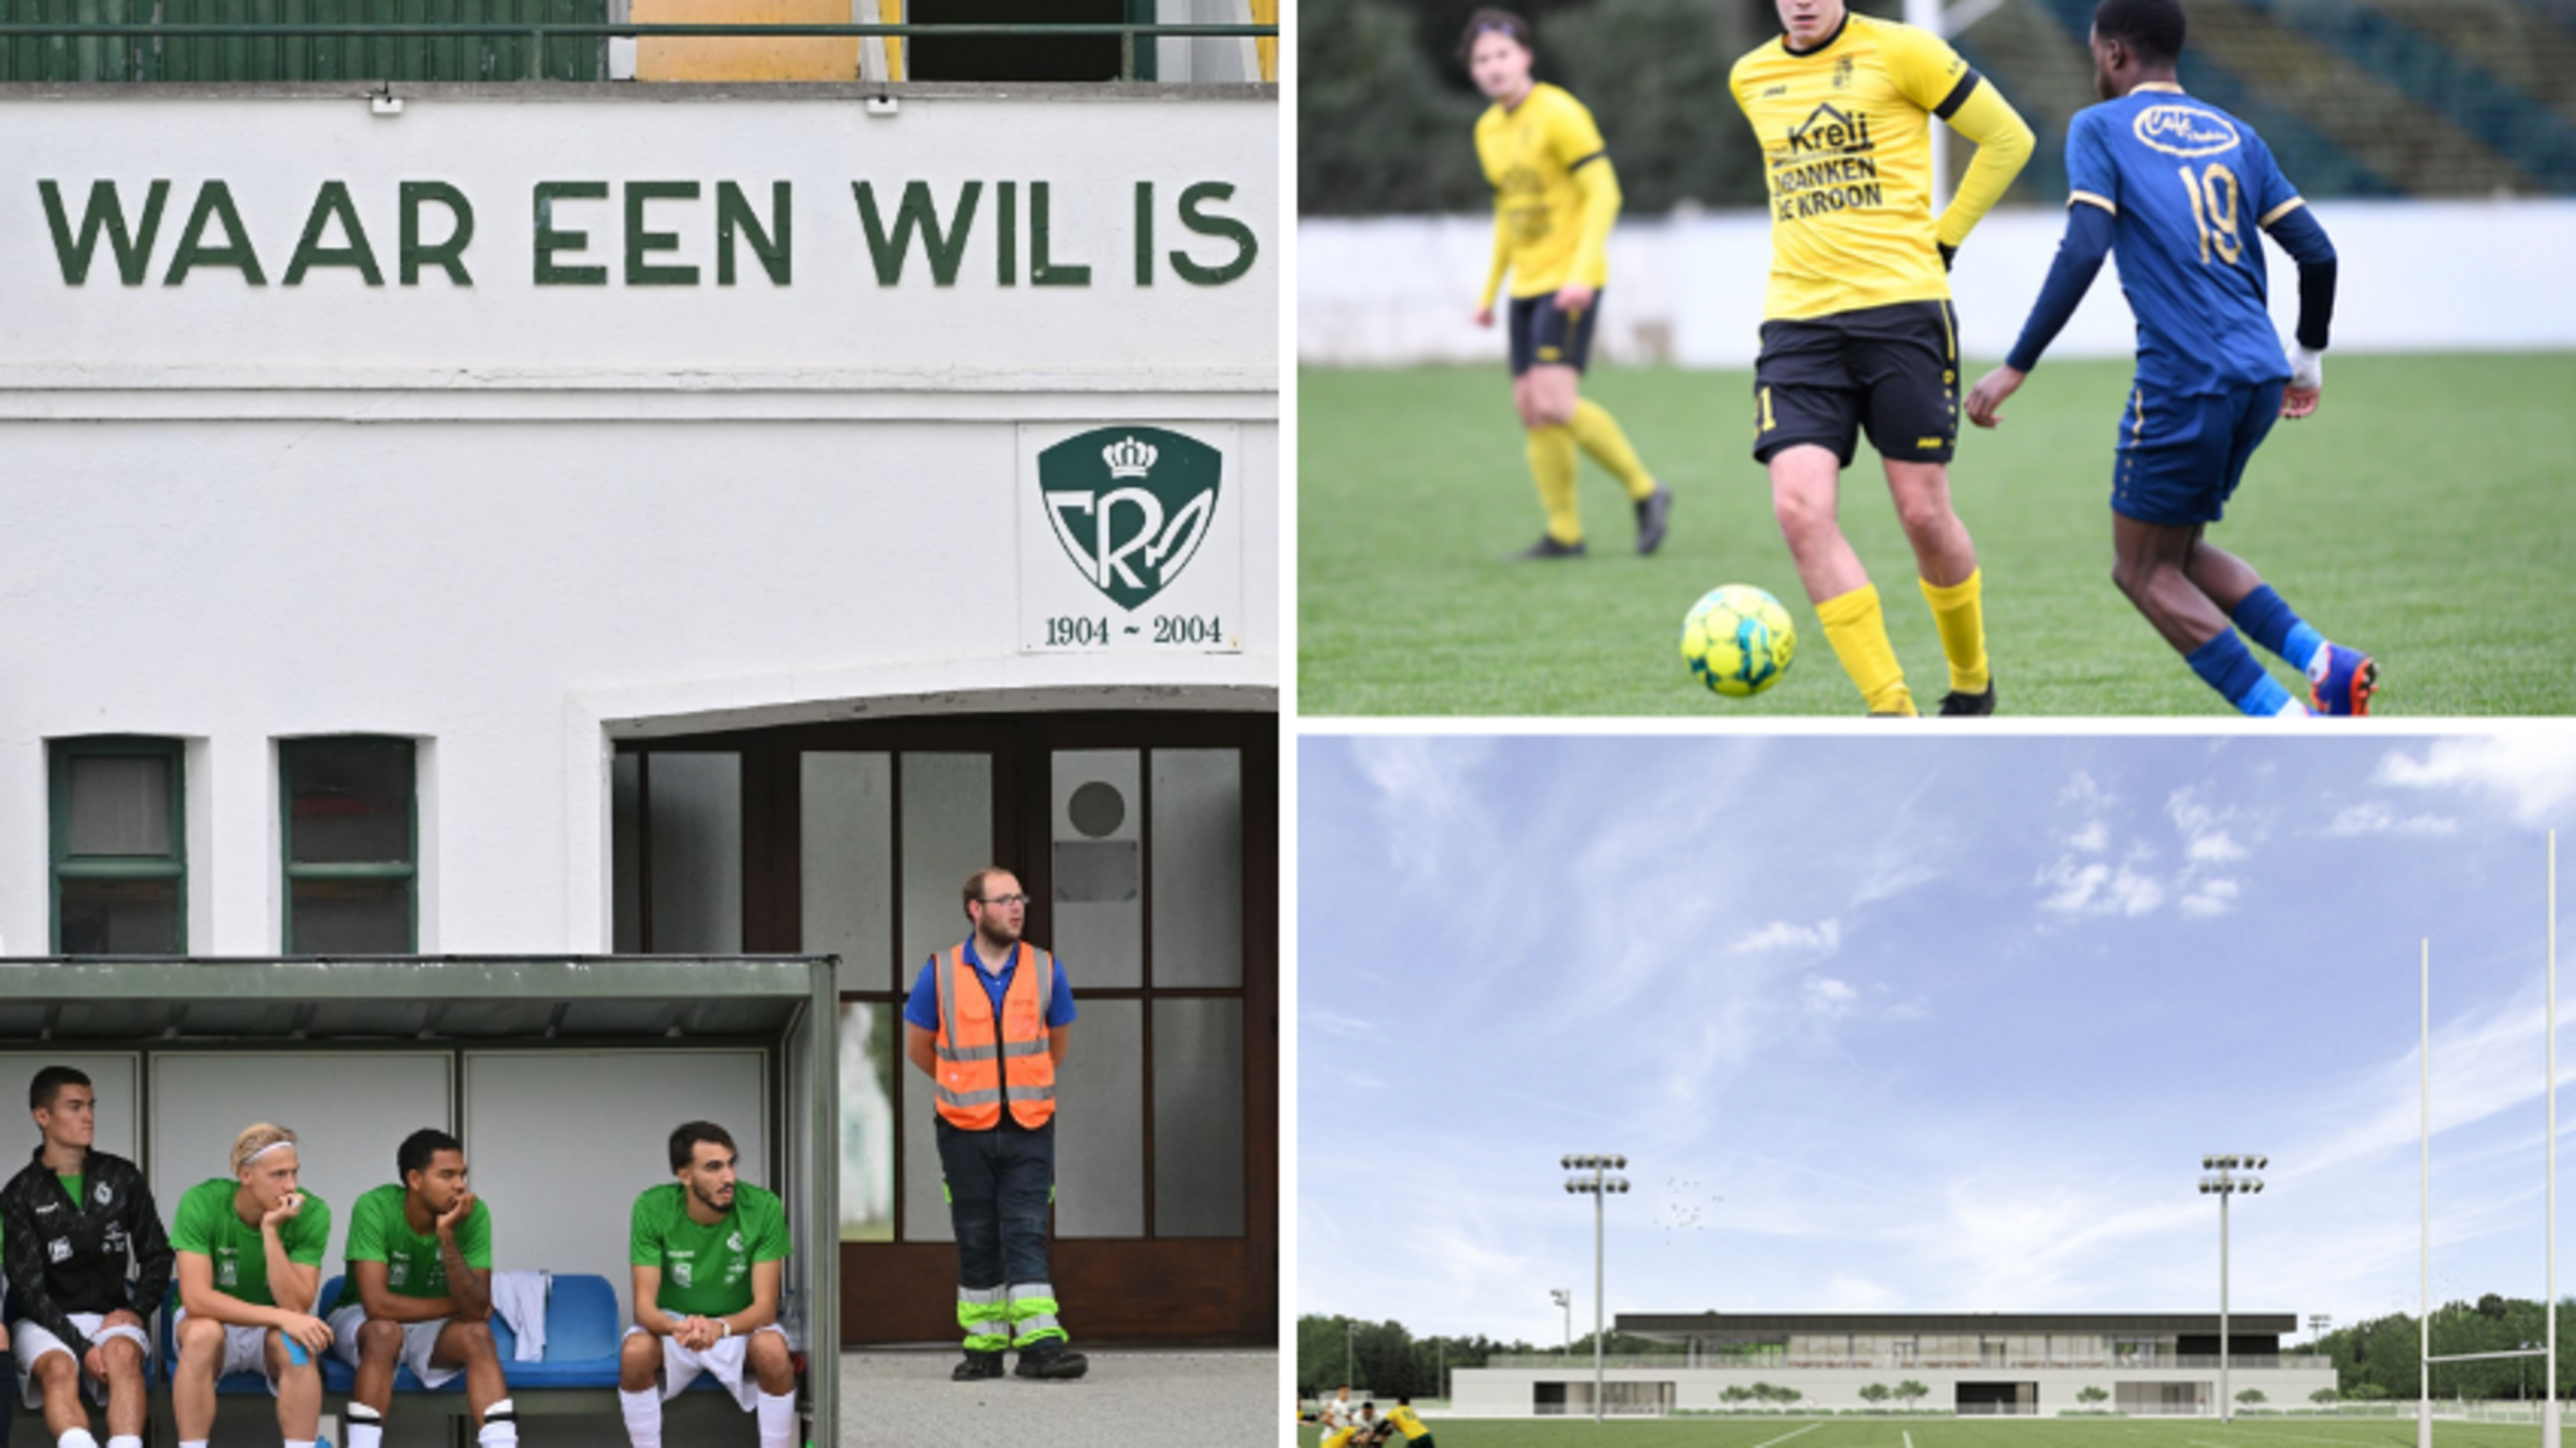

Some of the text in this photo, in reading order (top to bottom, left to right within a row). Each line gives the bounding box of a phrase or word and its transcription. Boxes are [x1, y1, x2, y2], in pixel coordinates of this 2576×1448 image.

[37, 179, 1258, 286] WAAR EEN WIL IS
[1797, 182, 1882, 218] KROON
[2179, 163, 2243, 264] 19
[1044, 616, 1110, 646] 1904
[1152, 614, 1222, 643] 2004
